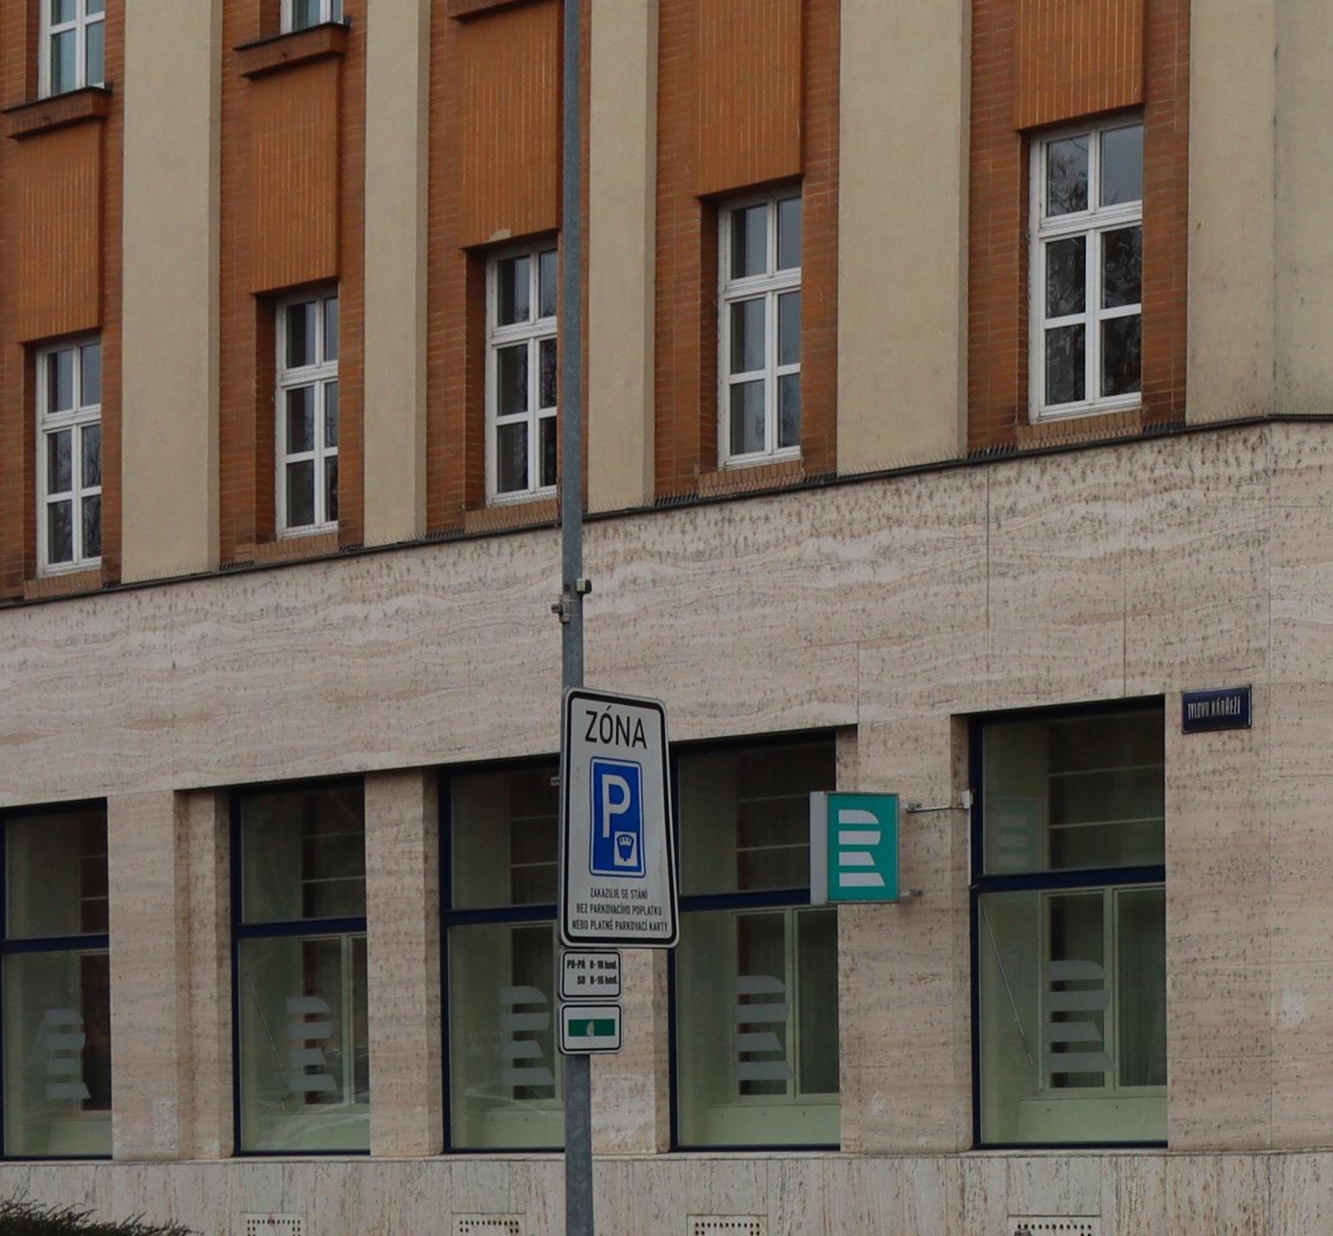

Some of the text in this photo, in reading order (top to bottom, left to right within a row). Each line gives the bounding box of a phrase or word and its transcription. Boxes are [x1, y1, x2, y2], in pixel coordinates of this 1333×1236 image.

[584, 704, 649, 750] ZÓNA
[590, 887, 648, 900] ZAKAZUJE SE STÁNÍ
[576, 902, 662, 916] BEZ PARKOVACÍHO POPLATKU
[572, 918, 668, 932] NEBO PLATNÉ PARKOVACÍ KARTY
